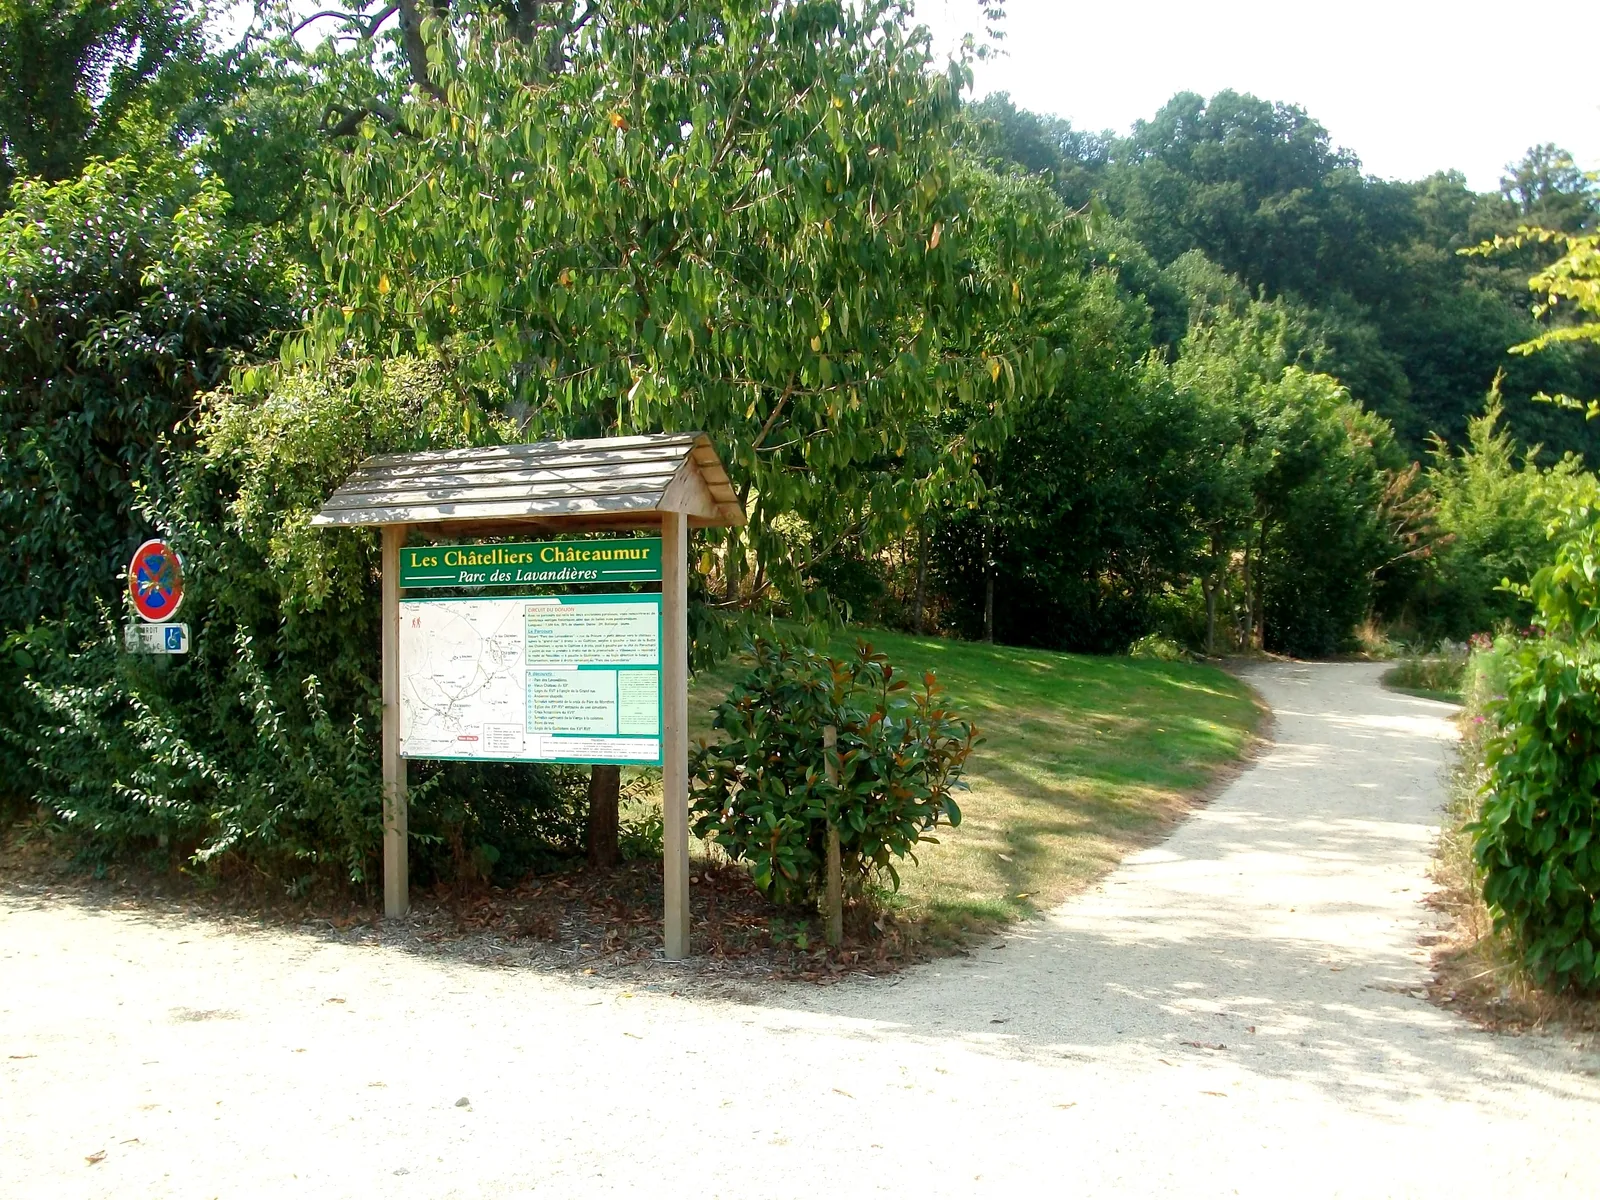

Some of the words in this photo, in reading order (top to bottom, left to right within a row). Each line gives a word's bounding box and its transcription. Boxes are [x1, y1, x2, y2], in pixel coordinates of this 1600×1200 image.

[410, 552, 438, 567] Les
[444, 548, 533, 566] Châtelliers
[540, 546, 650, 563] Châteaumur
[458, 570, 486, 583] Parc
[490, 569, 512, 582] des
[515, 566, 598, 581] Lavandières
